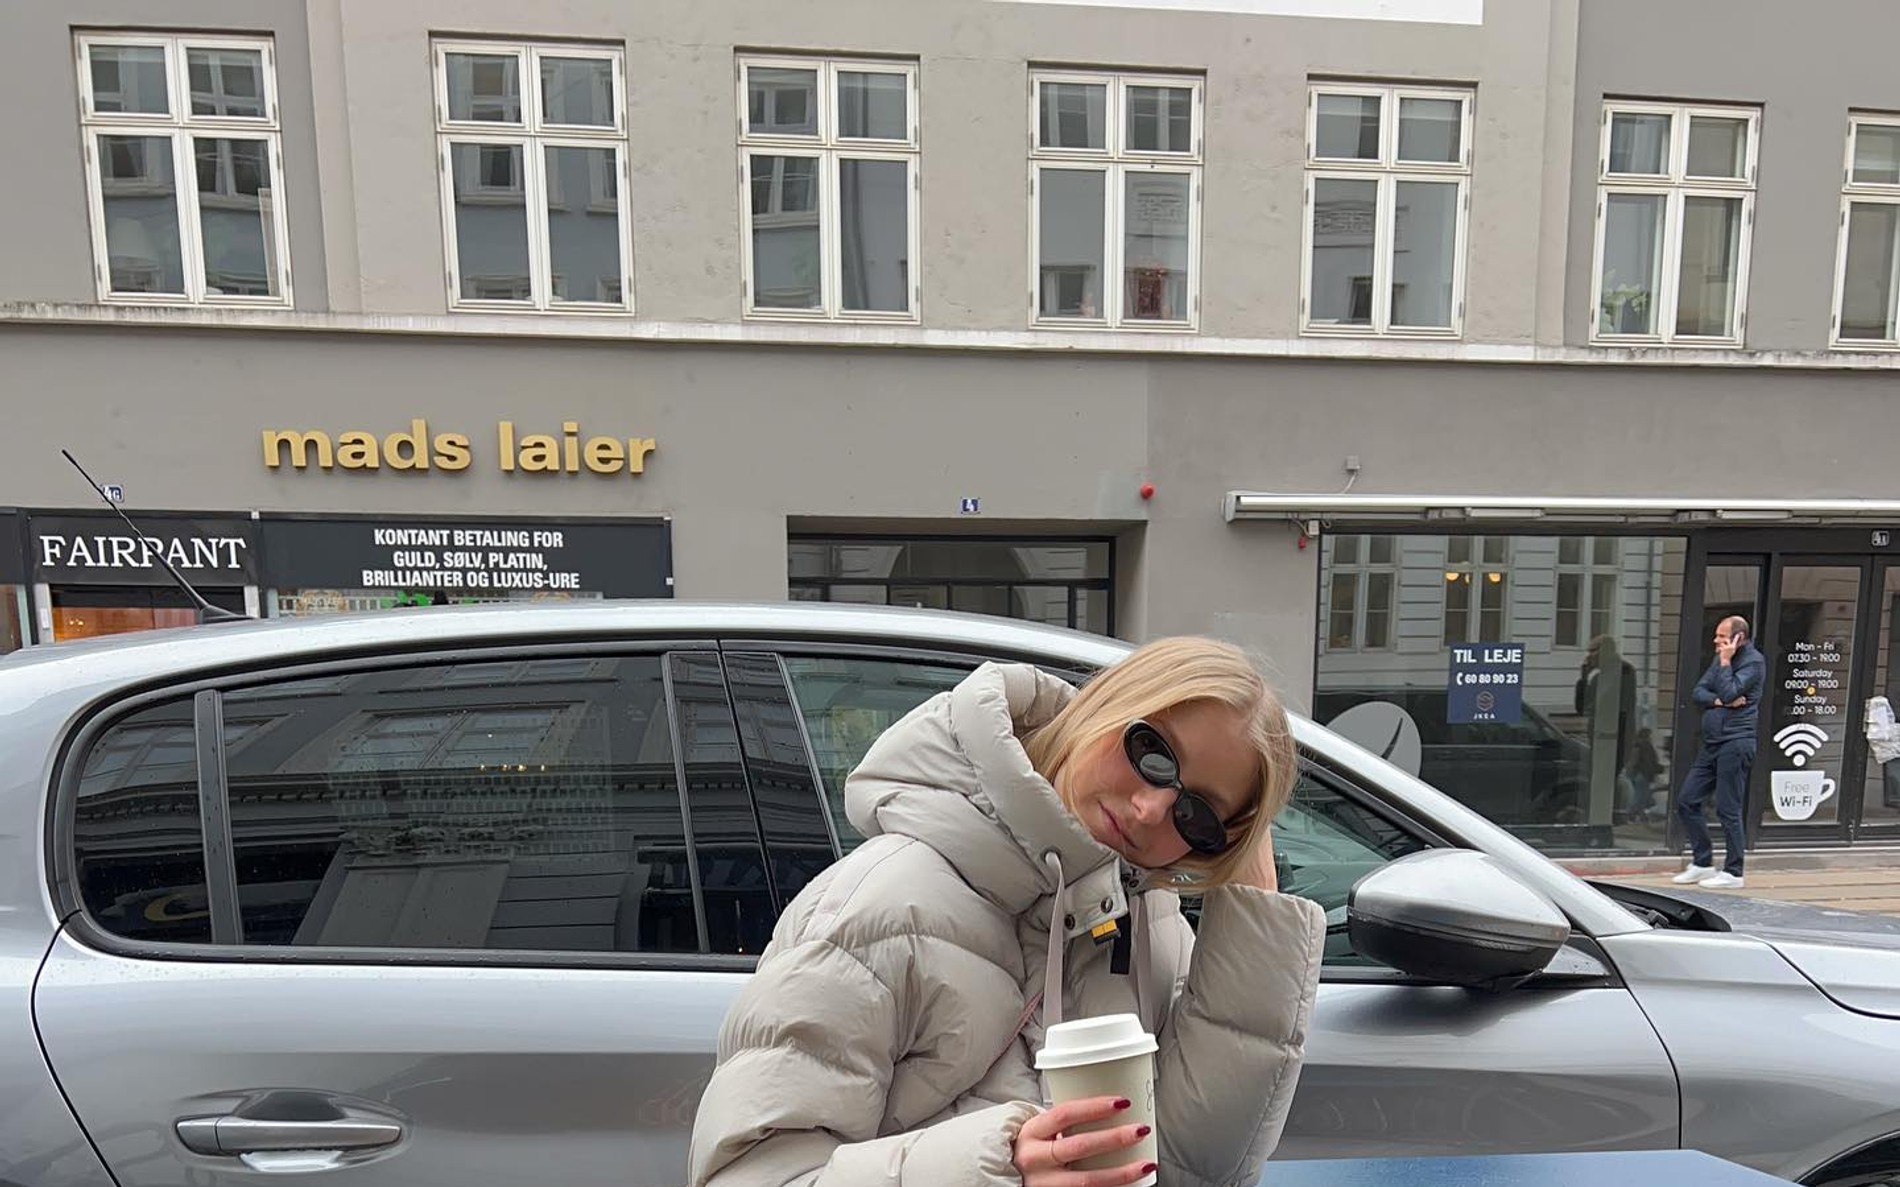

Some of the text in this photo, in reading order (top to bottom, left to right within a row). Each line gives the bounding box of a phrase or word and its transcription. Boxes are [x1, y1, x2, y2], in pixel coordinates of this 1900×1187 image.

[262, 418, 656, 474] mads laier
[374, 529, 564, 548] KONTANT BETALING FOR
[39, 535, 247, 569] FAIRPANT
[393, 551, 548, 571] GULD, SØLV, PLATIN,
[362, 570, 580, 589] BRILLIANTER OG LUXUS-URE
[1795, 642, 1815, 651] Mon
[1823, 641, 1835, 651] Fri
[1453, 649, 1522, 663] TIL LEJE
[1506, 673, 1519, 684] 23
[1792, 668, 1833, 678] Saturday
[1794, 694, 1828, 705] Sunday
[1784, 780, 1810, 793] Free
[1780, 795, 1813, 807] Wi-Fi
